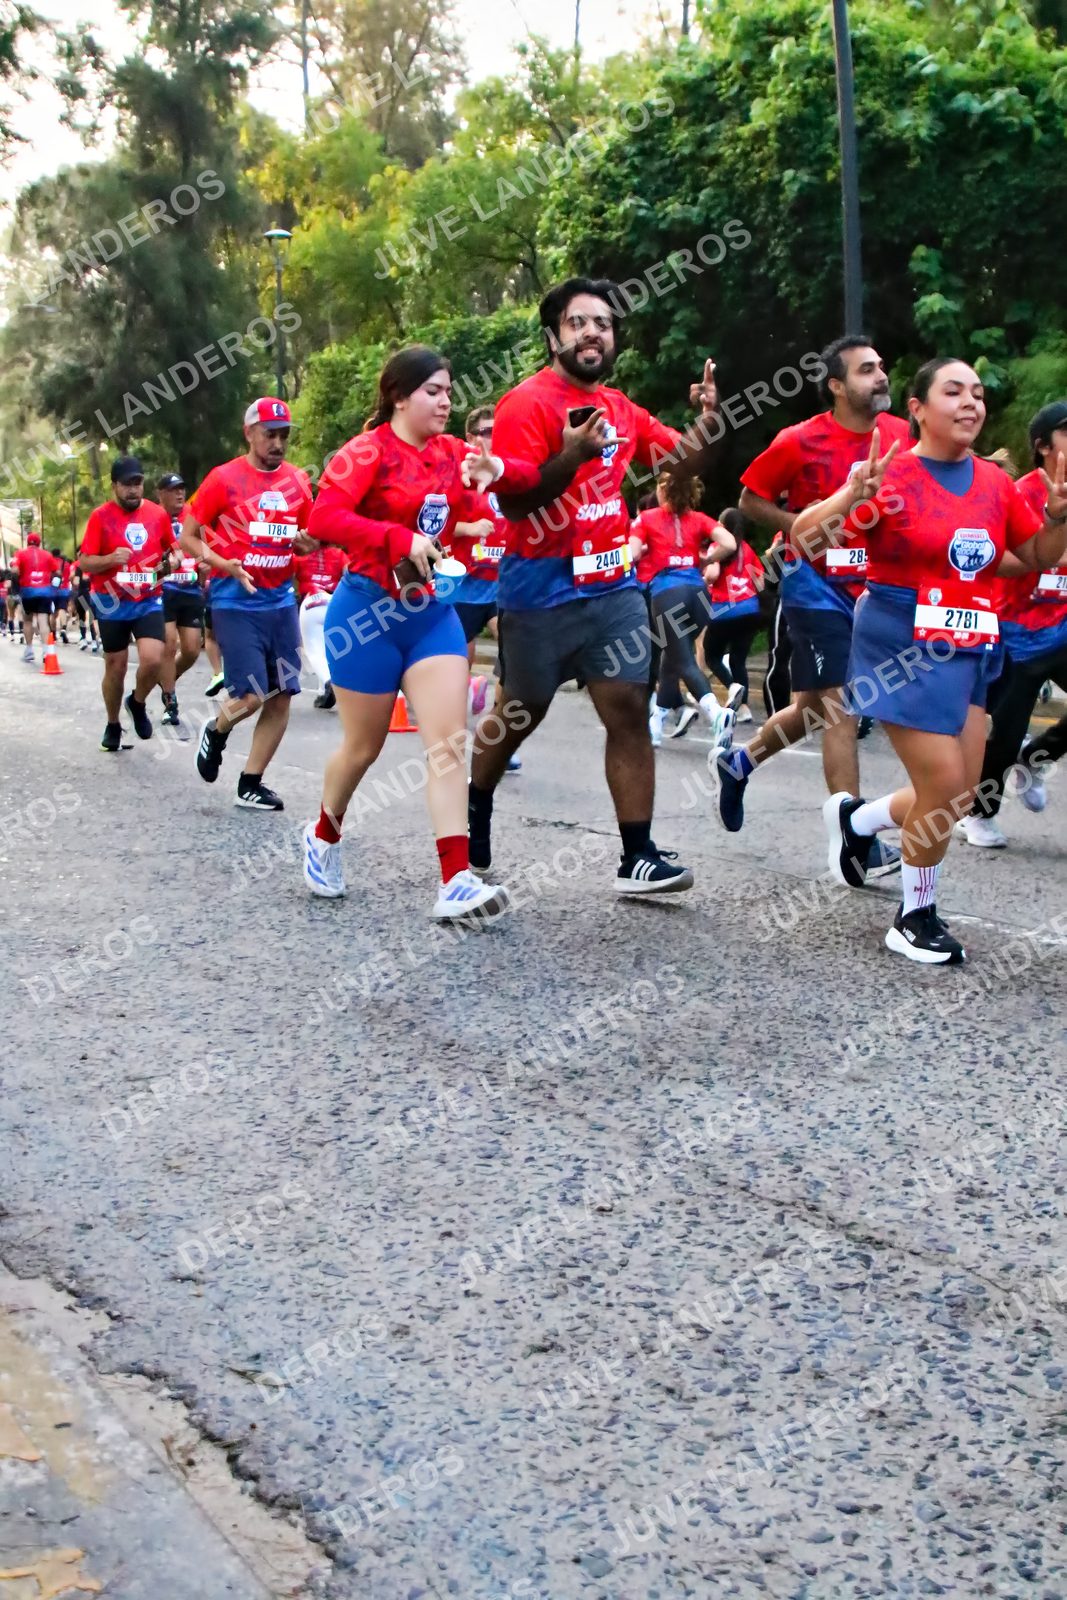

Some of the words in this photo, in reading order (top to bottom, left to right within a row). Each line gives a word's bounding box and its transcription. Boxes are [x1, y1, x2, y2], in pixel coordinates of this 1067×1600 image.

[267, 524, 288, 536] 1784
[596, 550, 620, 570] 2440
[849, 549, 867, 564] 28
[944, 609, 979, 630] 2781
